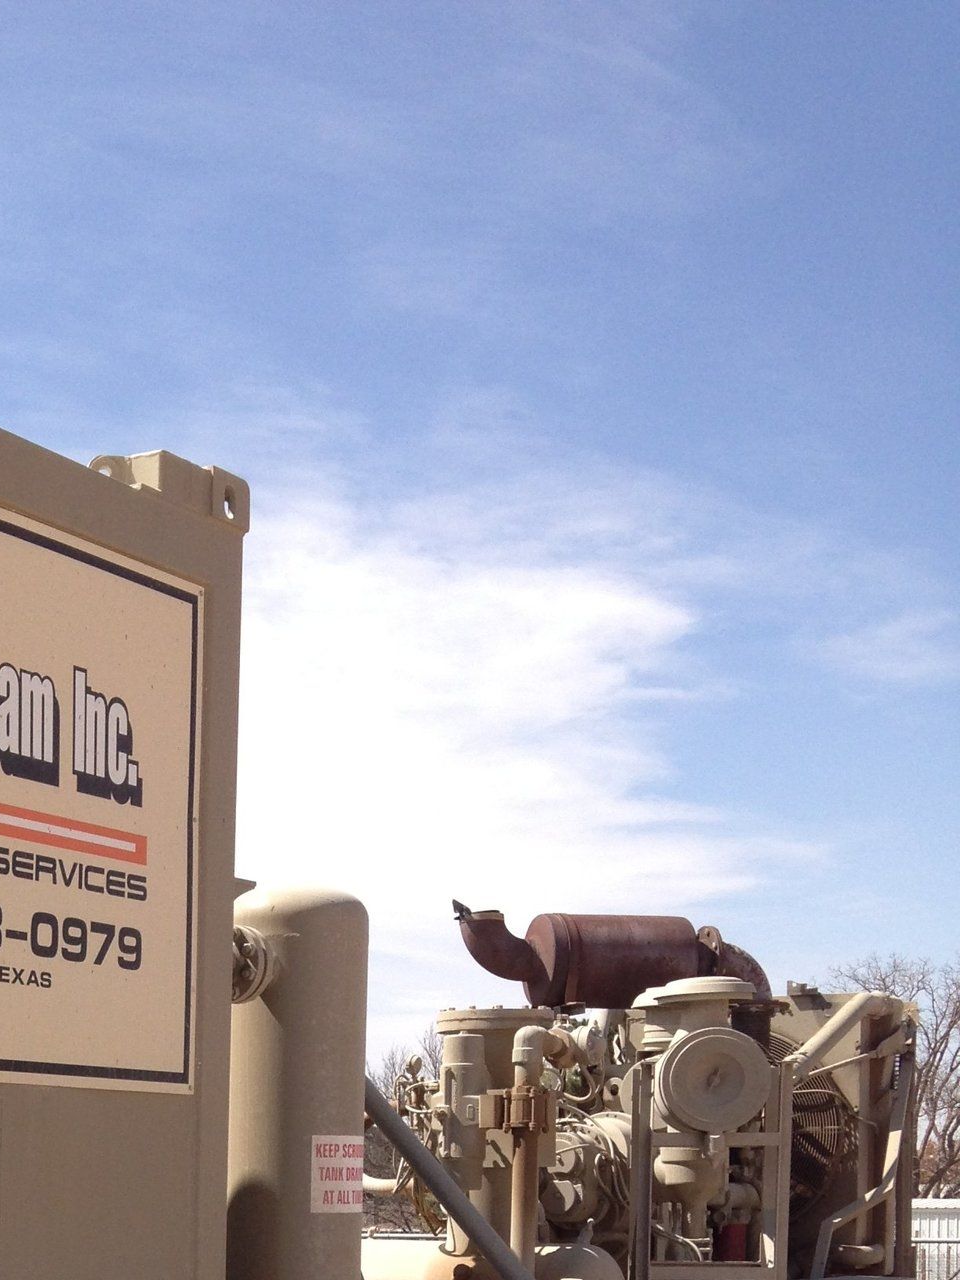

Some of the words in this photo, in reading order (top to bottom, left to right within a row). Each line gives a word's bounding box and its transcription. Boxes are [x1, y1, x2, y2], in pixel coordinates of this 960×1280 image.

[73, 665, 142, 807] Inc.
[316, 1143, 340, 1158] KEEP
[319, 1167, 344, 1181] TANK
[323, 1190, 335, 1205] AT
[337, 1190, 350, 1205] ALL
